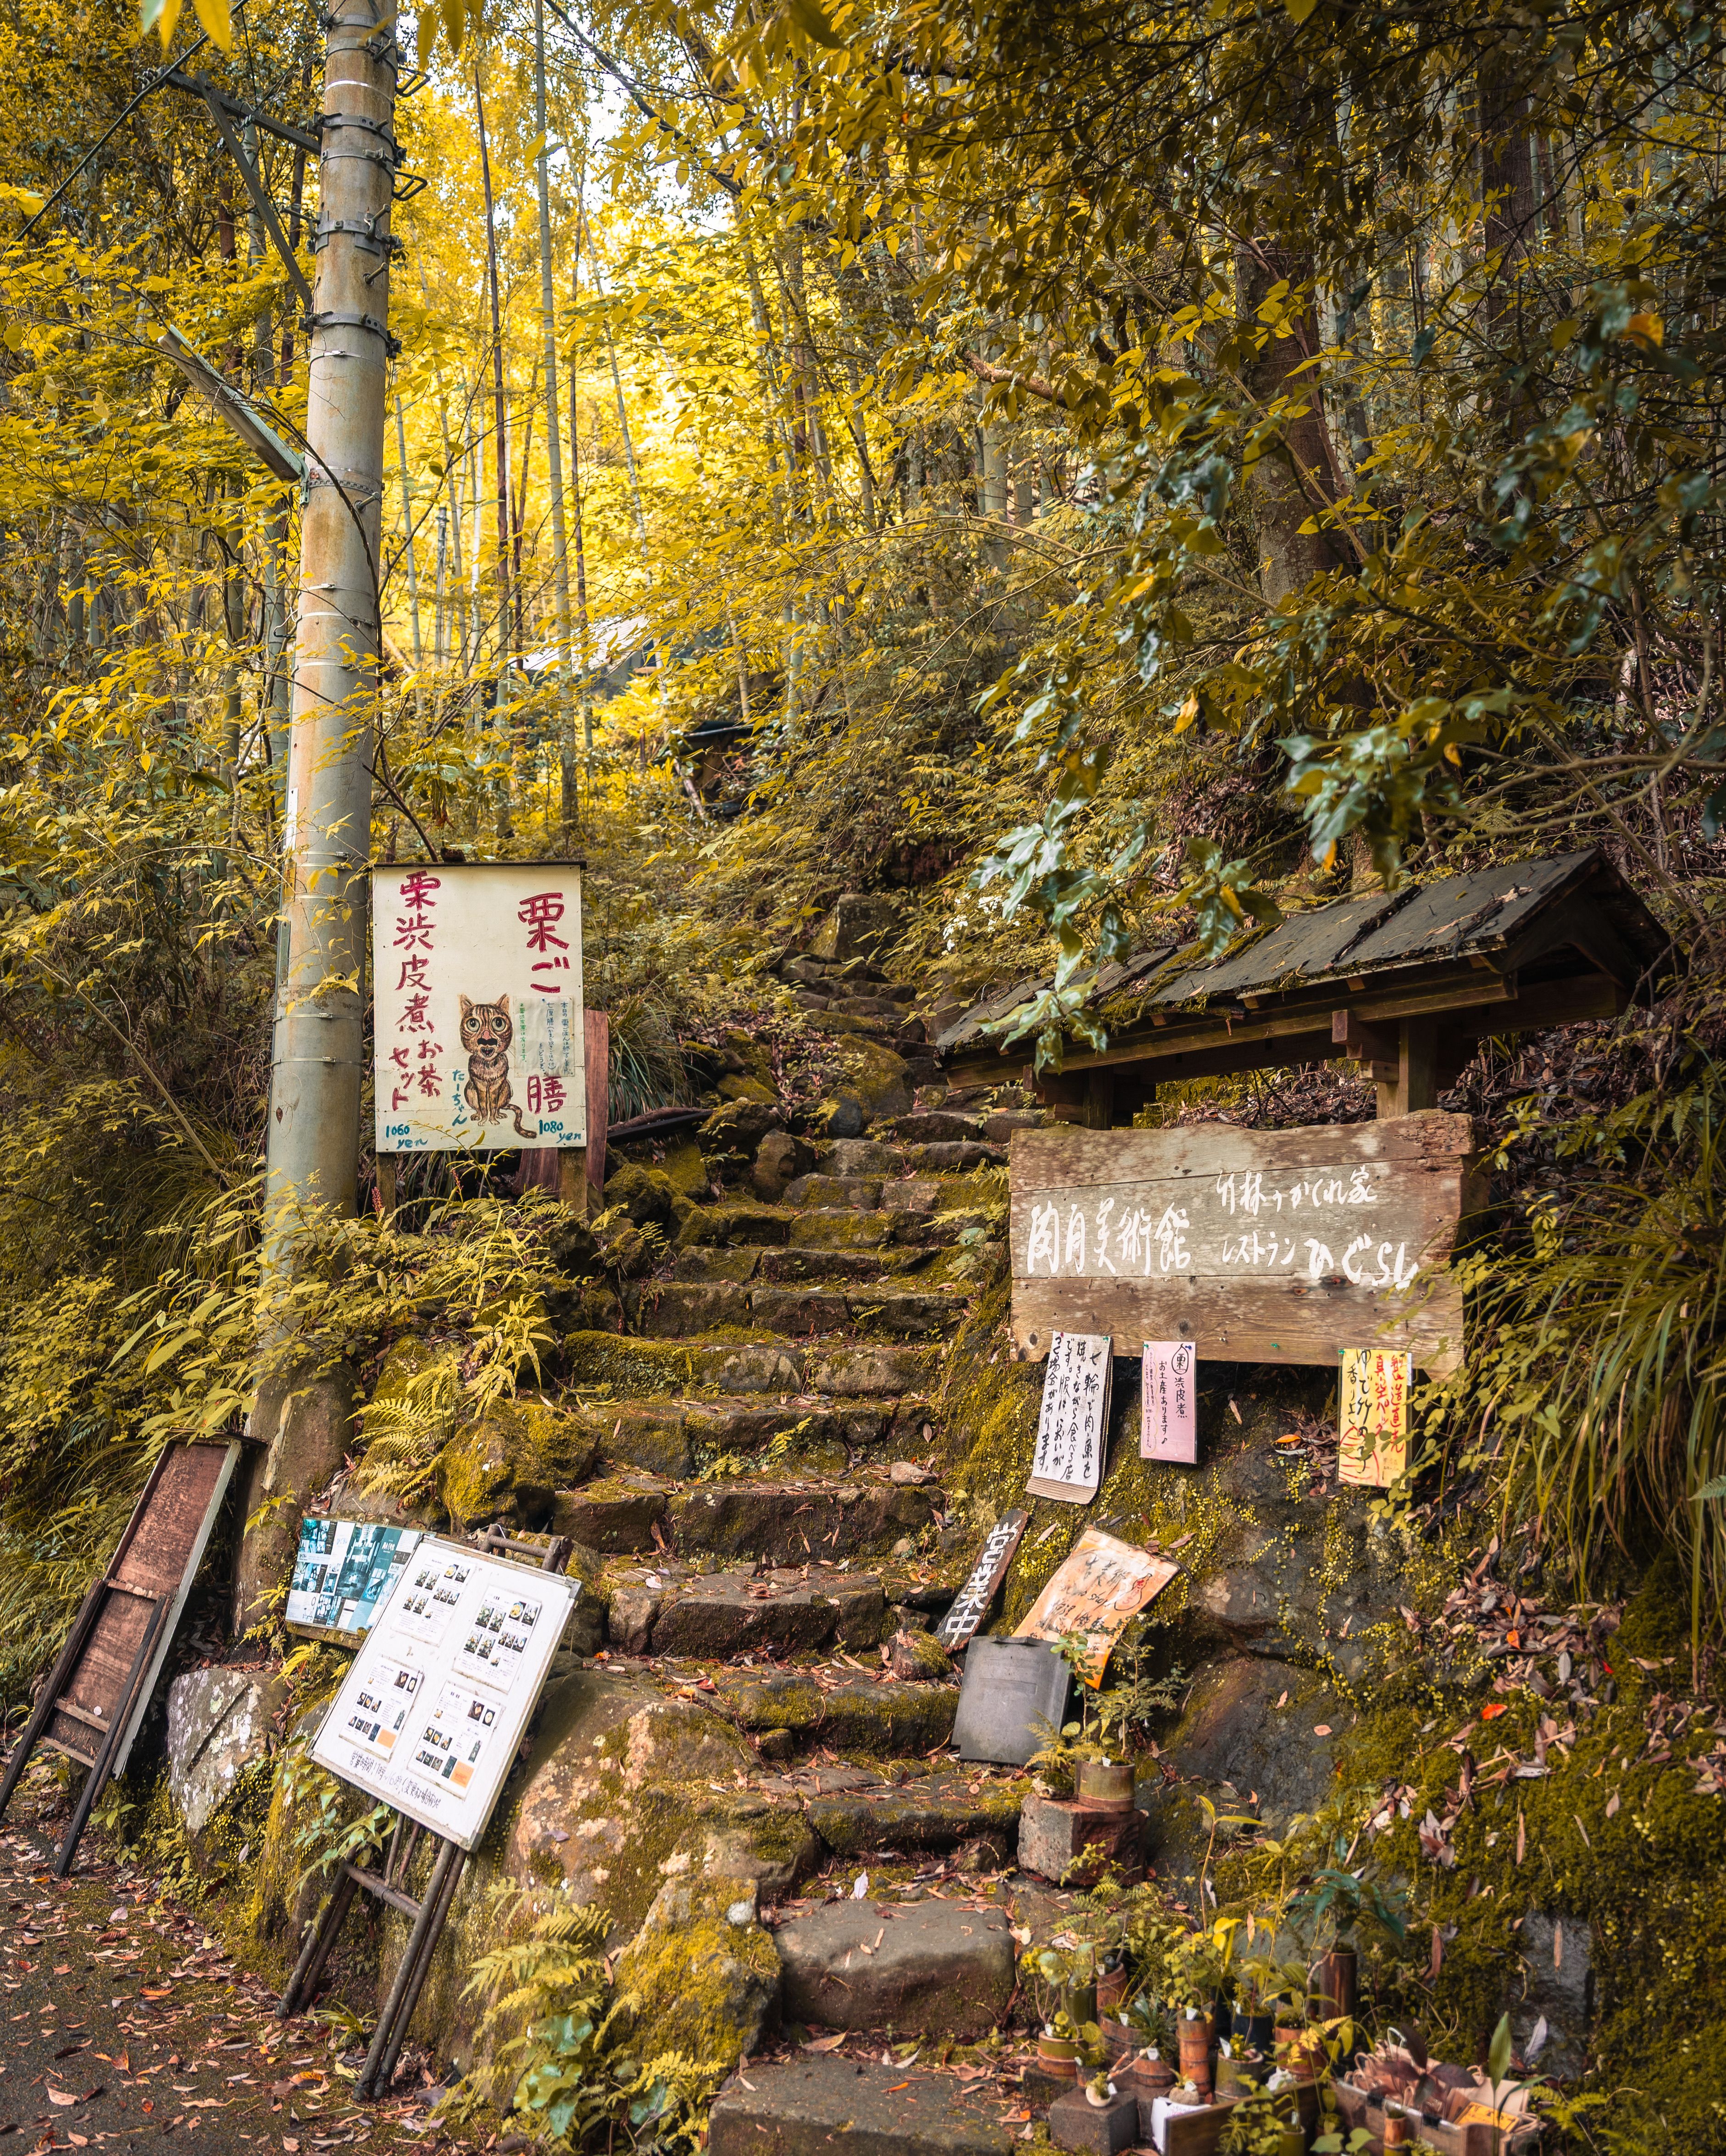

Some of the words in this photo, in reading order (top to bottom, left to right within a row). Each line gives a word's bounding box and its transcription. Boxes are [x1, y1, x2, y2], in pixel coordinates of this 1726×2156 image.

[389, 1047, 415, 1111] セット
[417, 1039, 444, 1097] お茶
[386, 1124, 410, 1138] 1060
[396, 1138, 428, 1149] yen
[538, 1119, 563, 1135] 1080
[555, 1132, 581, 1144] yen
[945, 1519, 1021, 1647] 営業中
